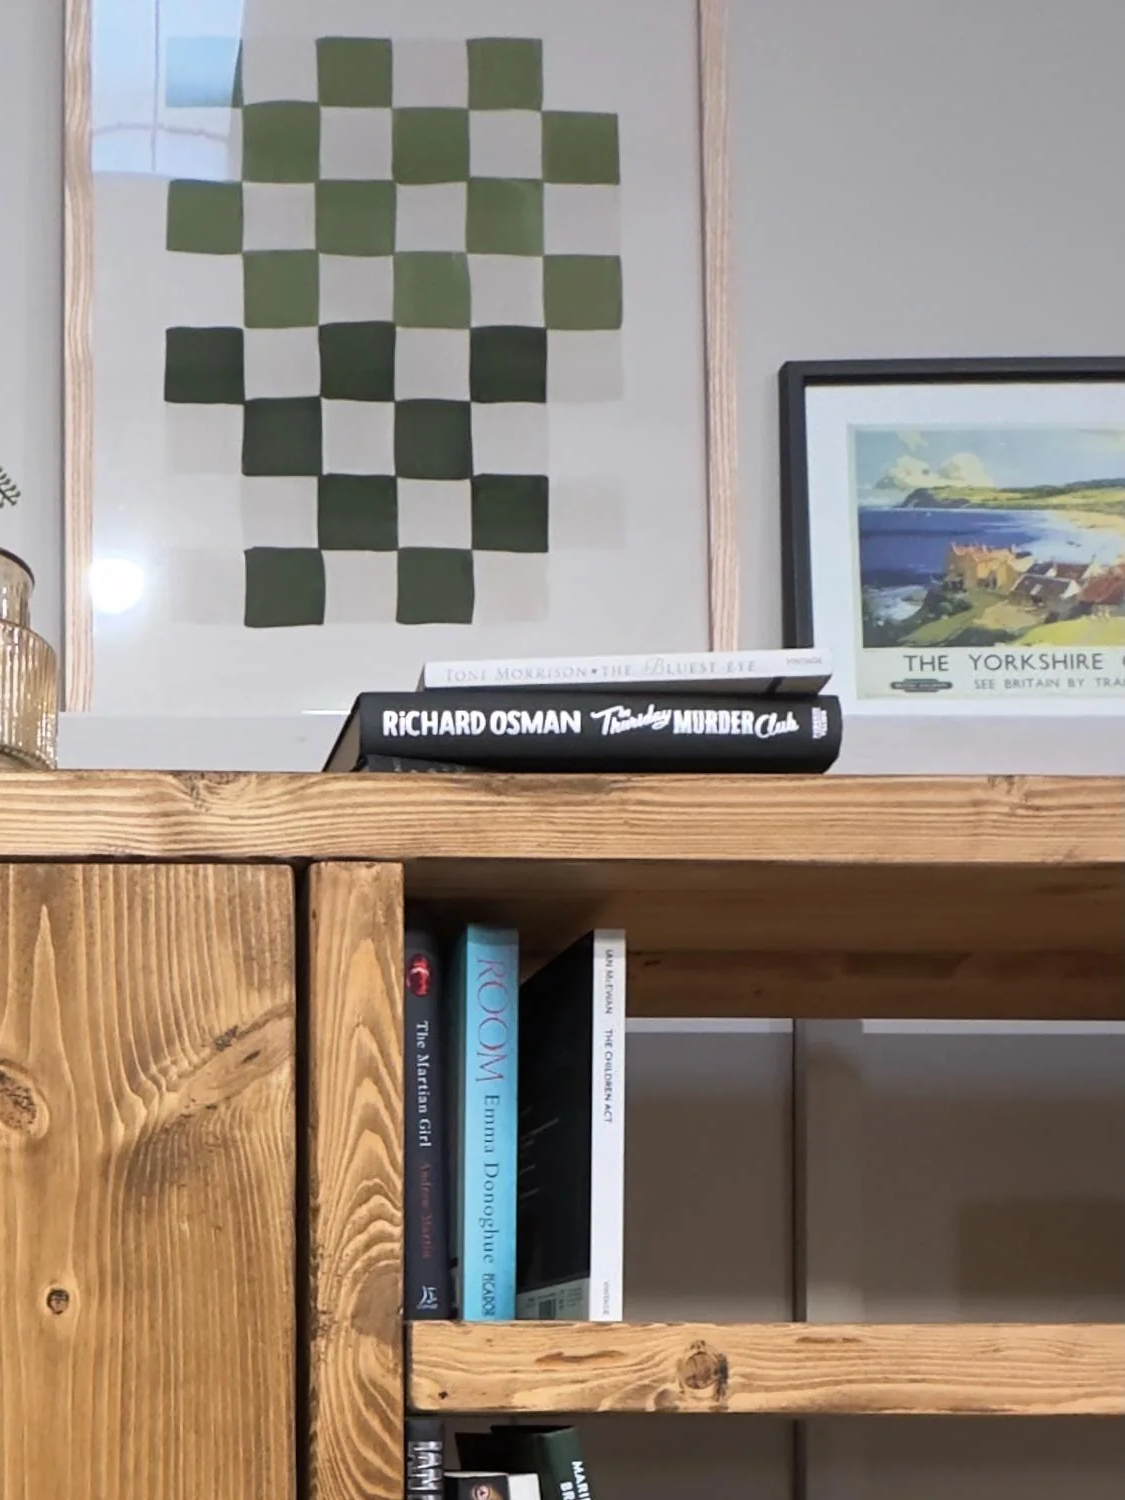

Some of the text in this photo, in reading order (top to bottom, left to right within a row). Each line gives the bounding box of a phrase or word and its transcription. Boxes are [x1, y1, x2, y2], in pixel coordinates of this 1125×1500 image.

[903, 654, 949, 672] THE
[969, 653, 1103, 671] YORKSHIRE
[974, 678, 995, 690] SEE
[1004, 678, 1059, 689] BRITAIN
[1068, 677, 1085, 688] BY
[490, 710, 582, 736] OSMAN
[673, 709, 755, 735] MURDER
[755, 711, 800, 739] Club
[605, 949, 614, 968] IAN
[475, 958, 508, 1083] ROOM
[416, 1019, 432, 1148] The Martian Girl
[603, 1029, 613, 1124] THE CHILDREN ACT
[478, 1094, 500, 1264] Emma Donoghue
